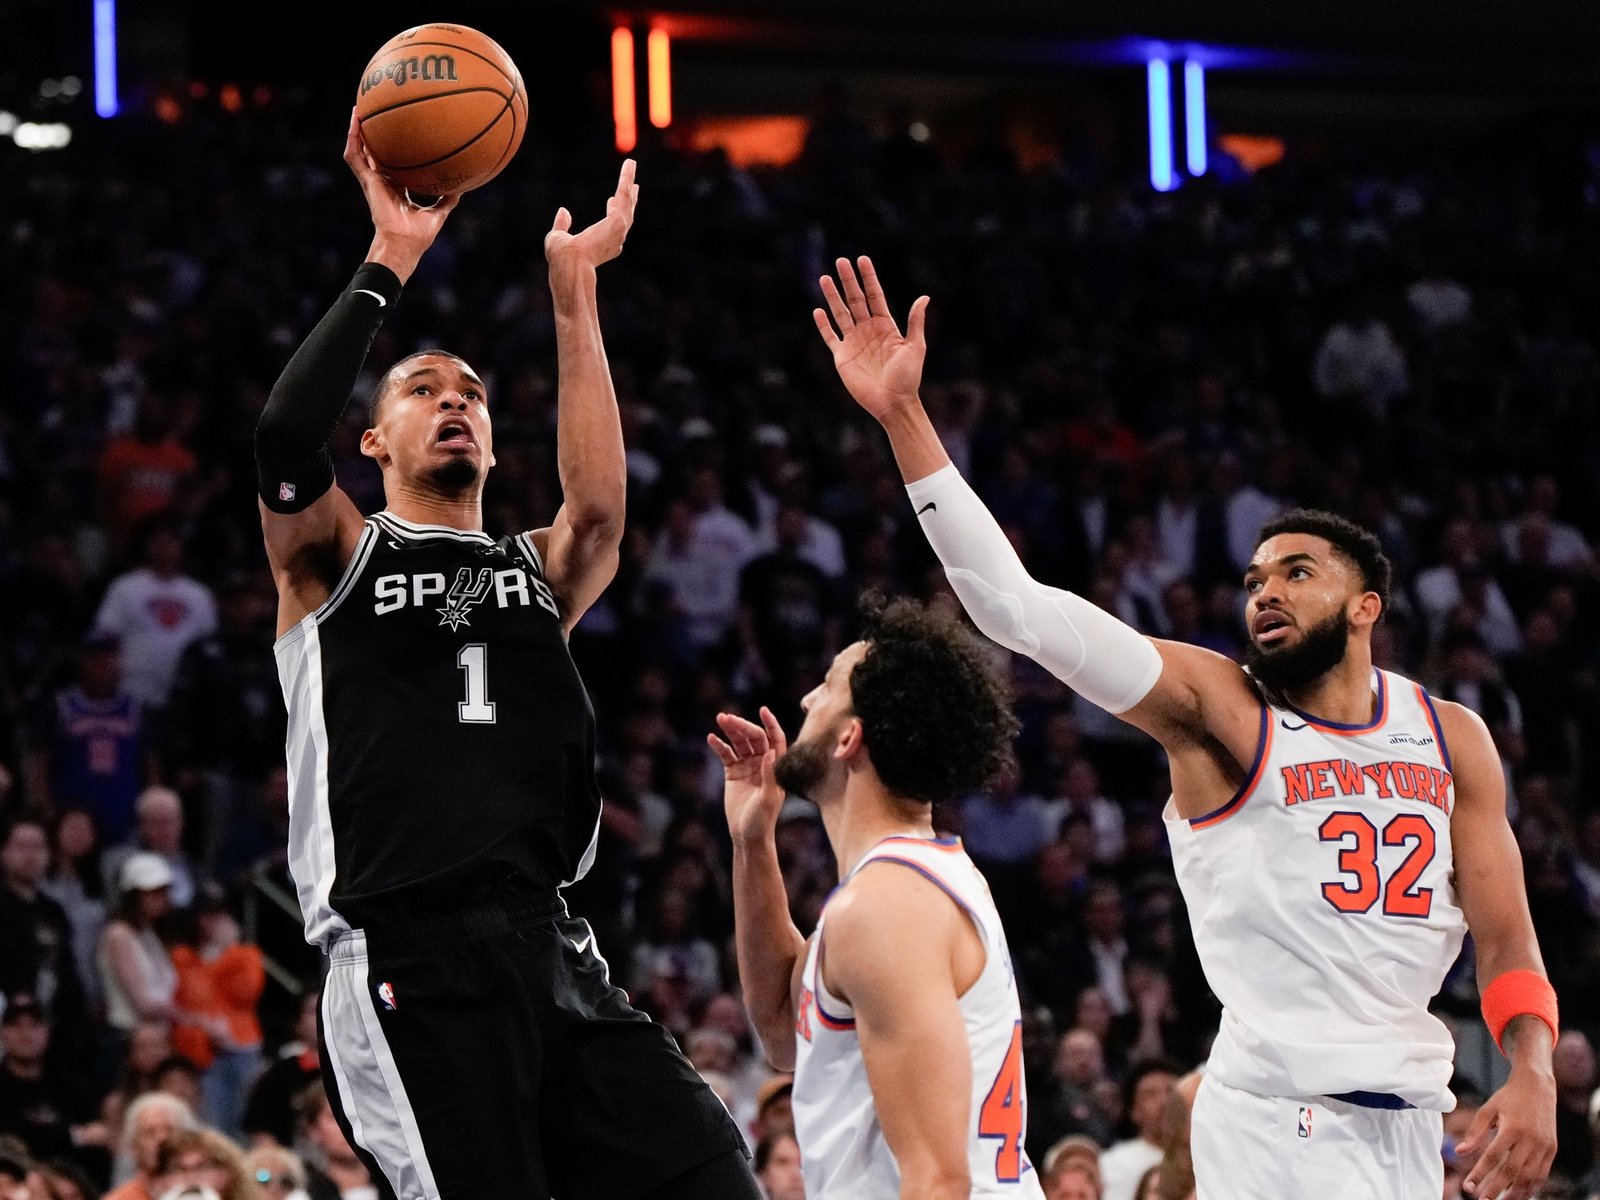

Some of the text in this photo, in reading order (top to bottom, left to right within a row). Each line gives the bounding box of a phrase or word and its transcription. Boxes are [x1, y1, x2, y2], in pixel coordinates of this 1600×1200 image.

[361, 54, 458, 97] Wilson
[374, 567, 560, 632] SPURS
[456, 642, 497, 724] 1
[1280, 758, 1452, 816] NEW YORK
[1318, 811, 1435, 919] 32
